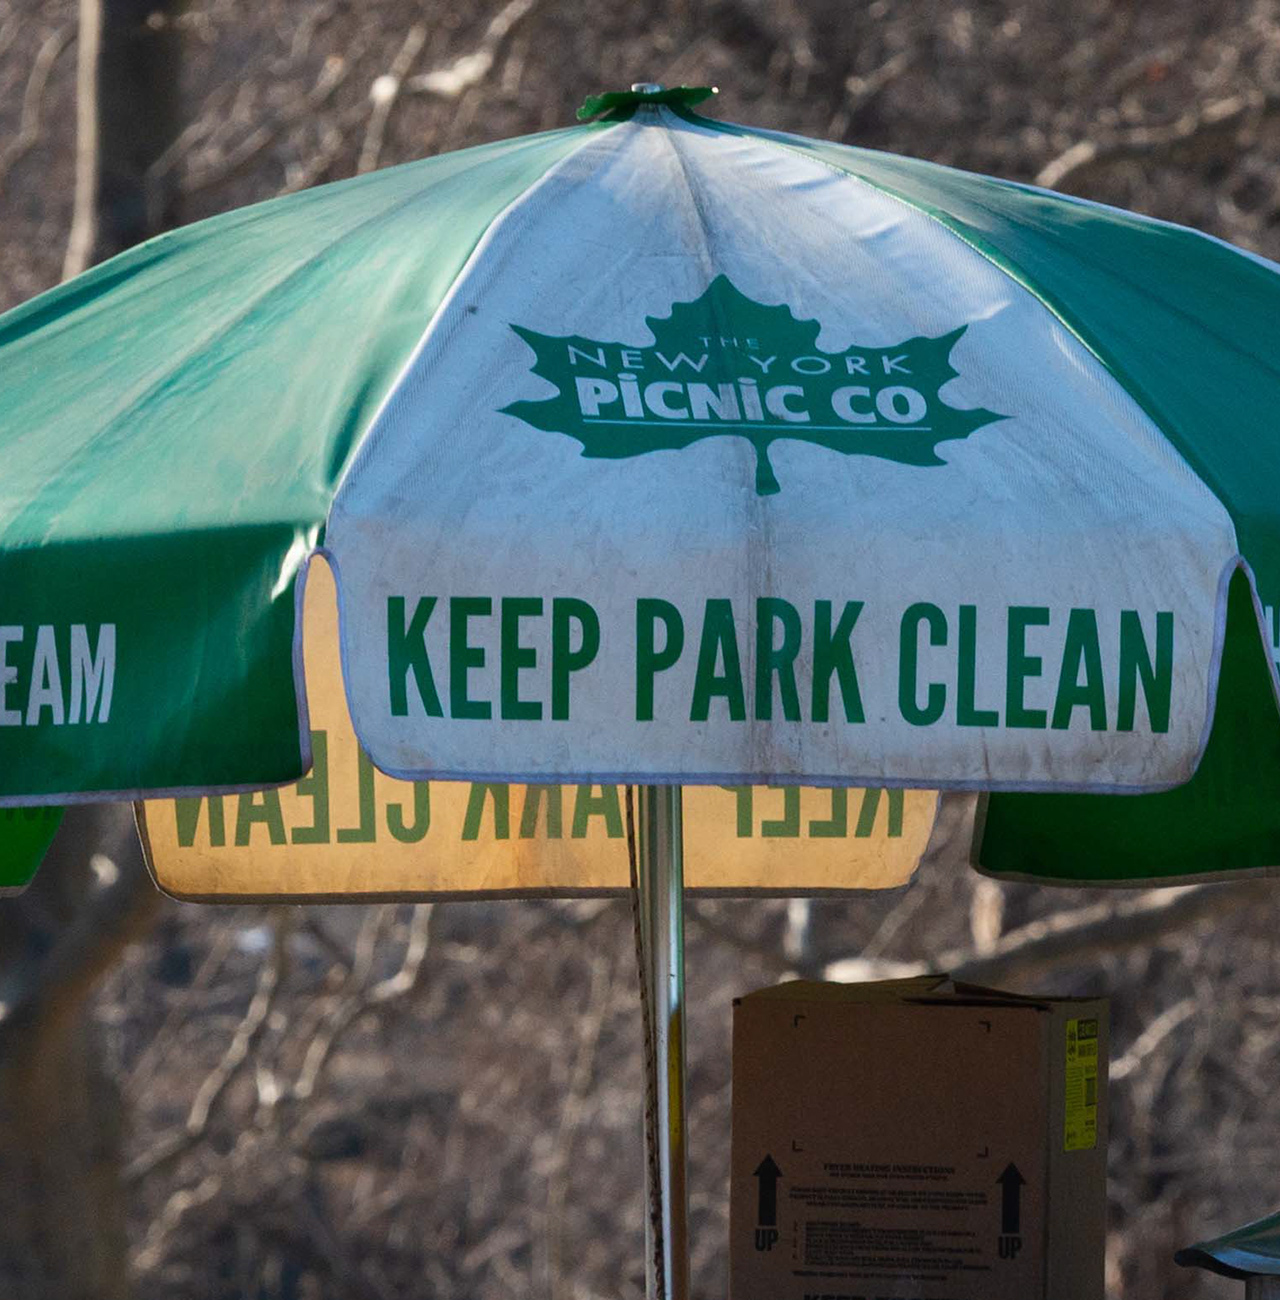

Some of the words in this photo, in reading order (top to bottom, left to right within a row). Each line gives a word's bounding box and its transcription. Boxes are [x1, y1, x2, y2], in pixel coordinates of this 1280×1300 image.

[699, 336, 759, 350] THE
[568, 344, 709, 373] NEW
[748, 355, 914, 375] YORK
[831, 385, 927, 424] CO
[387, 596, 601, 722] KEEP
[635, 598, 866, 725] PARK
[898, 604, 1174, 734] CLEAN
[755, 1228, 779, 1252] UP
[998, 1236, 1022, 1260] UP
